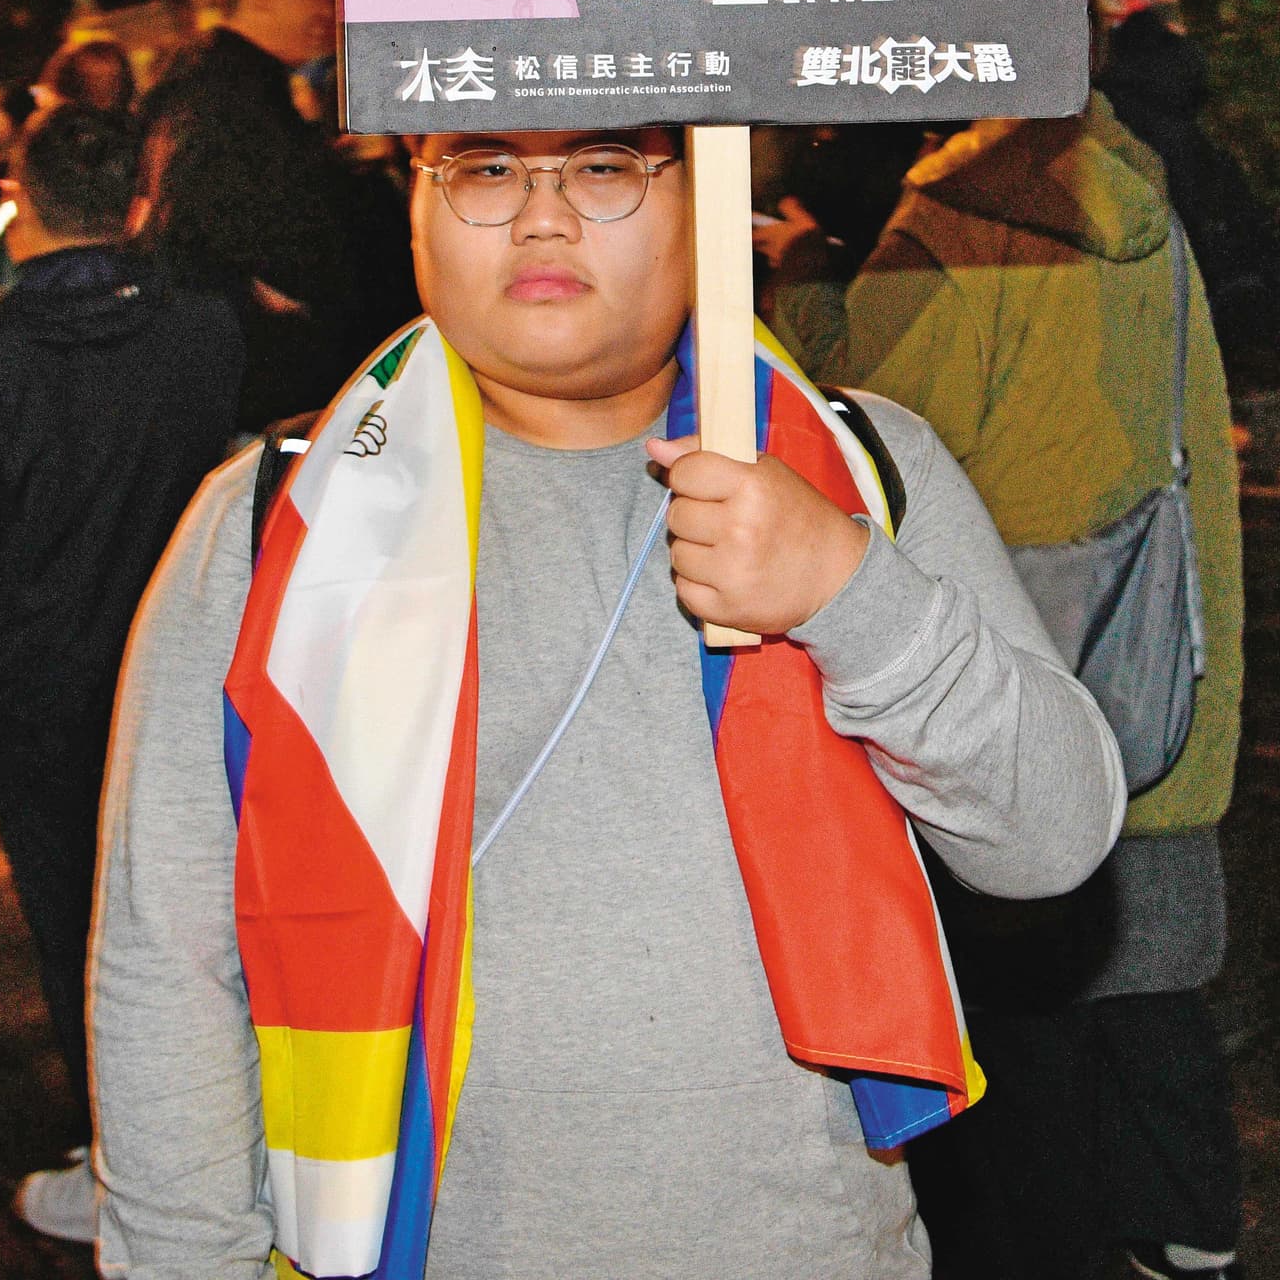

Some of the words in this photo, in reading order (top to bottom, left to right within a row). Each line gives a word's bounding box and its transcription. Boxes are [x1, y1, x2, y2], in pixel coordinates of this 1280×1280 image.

[515, 51, 731, 81] 松信民主行動
[514, 87, 545, 97] SONG
[547, 86, 566, 96] XIN
[568, 85, 631, 96] Democratic
[632, 84, 667, 95] Action
[669, 82, 732, 94] Association
